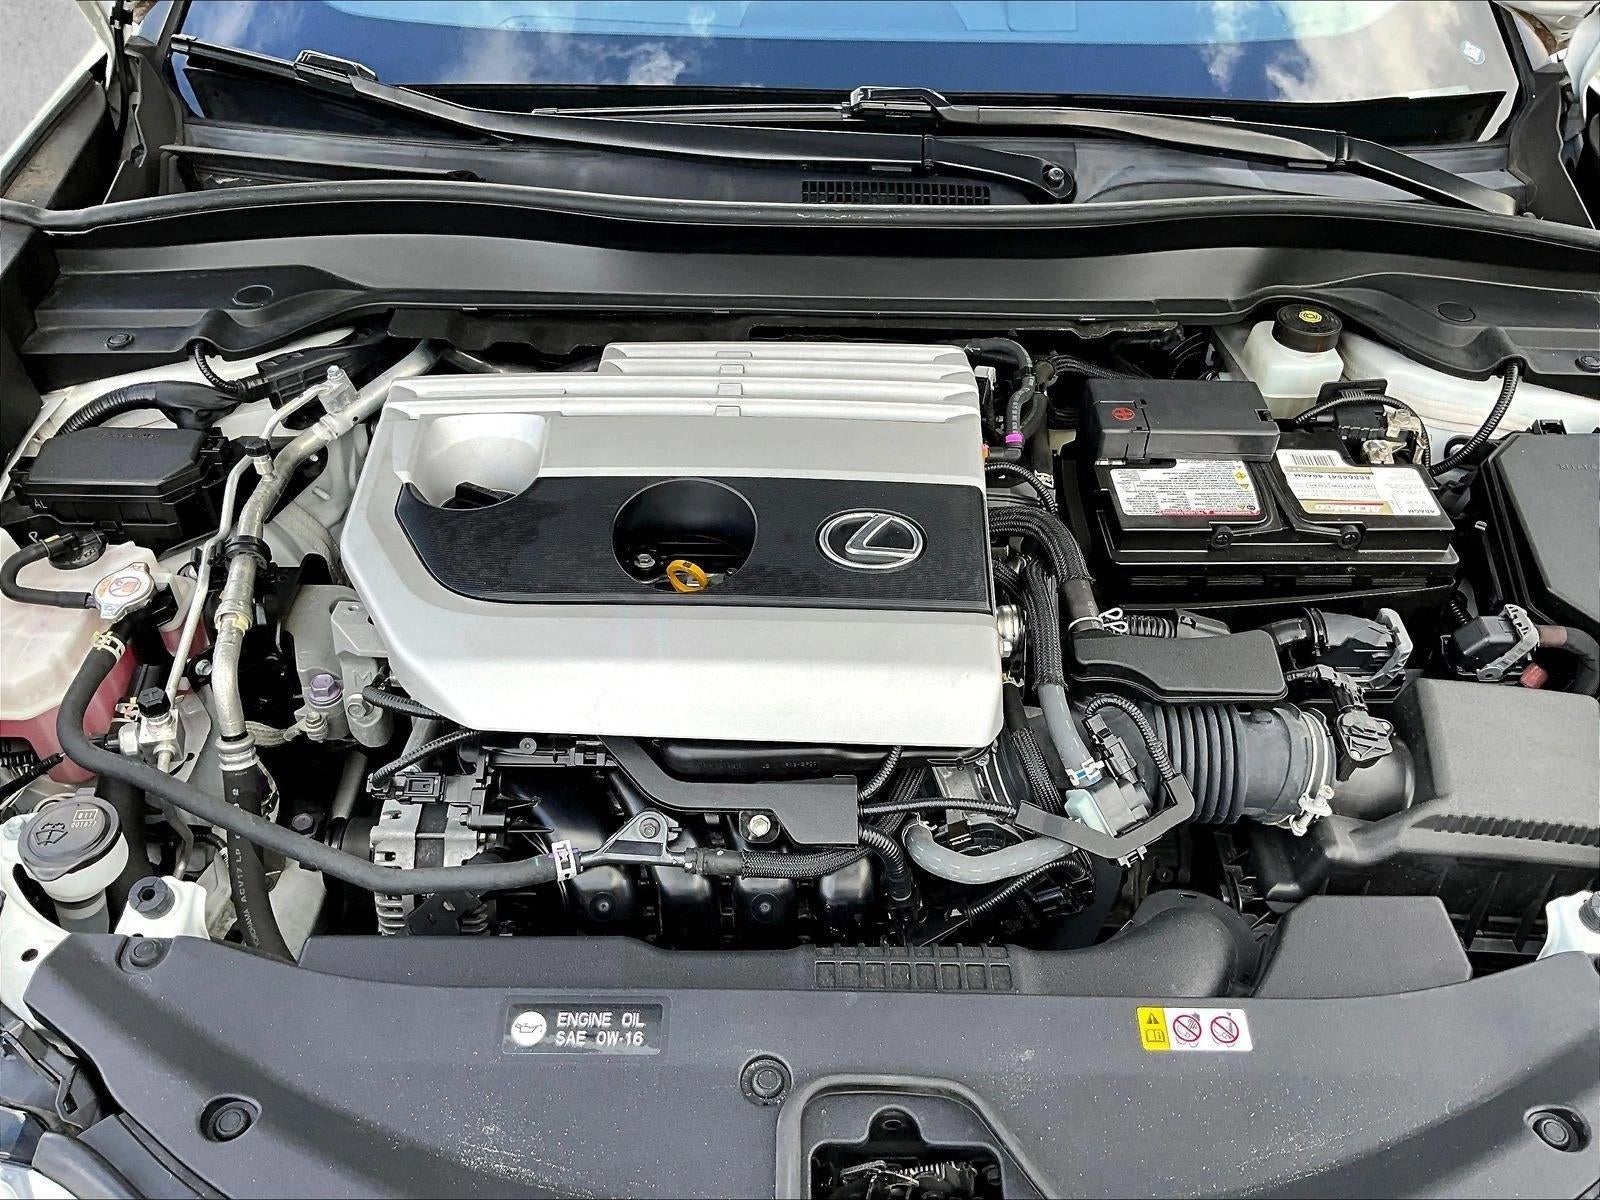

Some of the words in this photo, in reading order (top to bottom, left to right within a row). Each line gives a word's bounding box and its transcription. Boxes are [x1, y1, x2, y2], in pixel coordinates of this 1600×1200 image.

[556, 1011, 614, 1028] ENGINE
[621, 1011, 646, 1028] OIL
[554, 1030, 588, 1048] SAE
[595, 1030, 645, 1048] 0W-16
